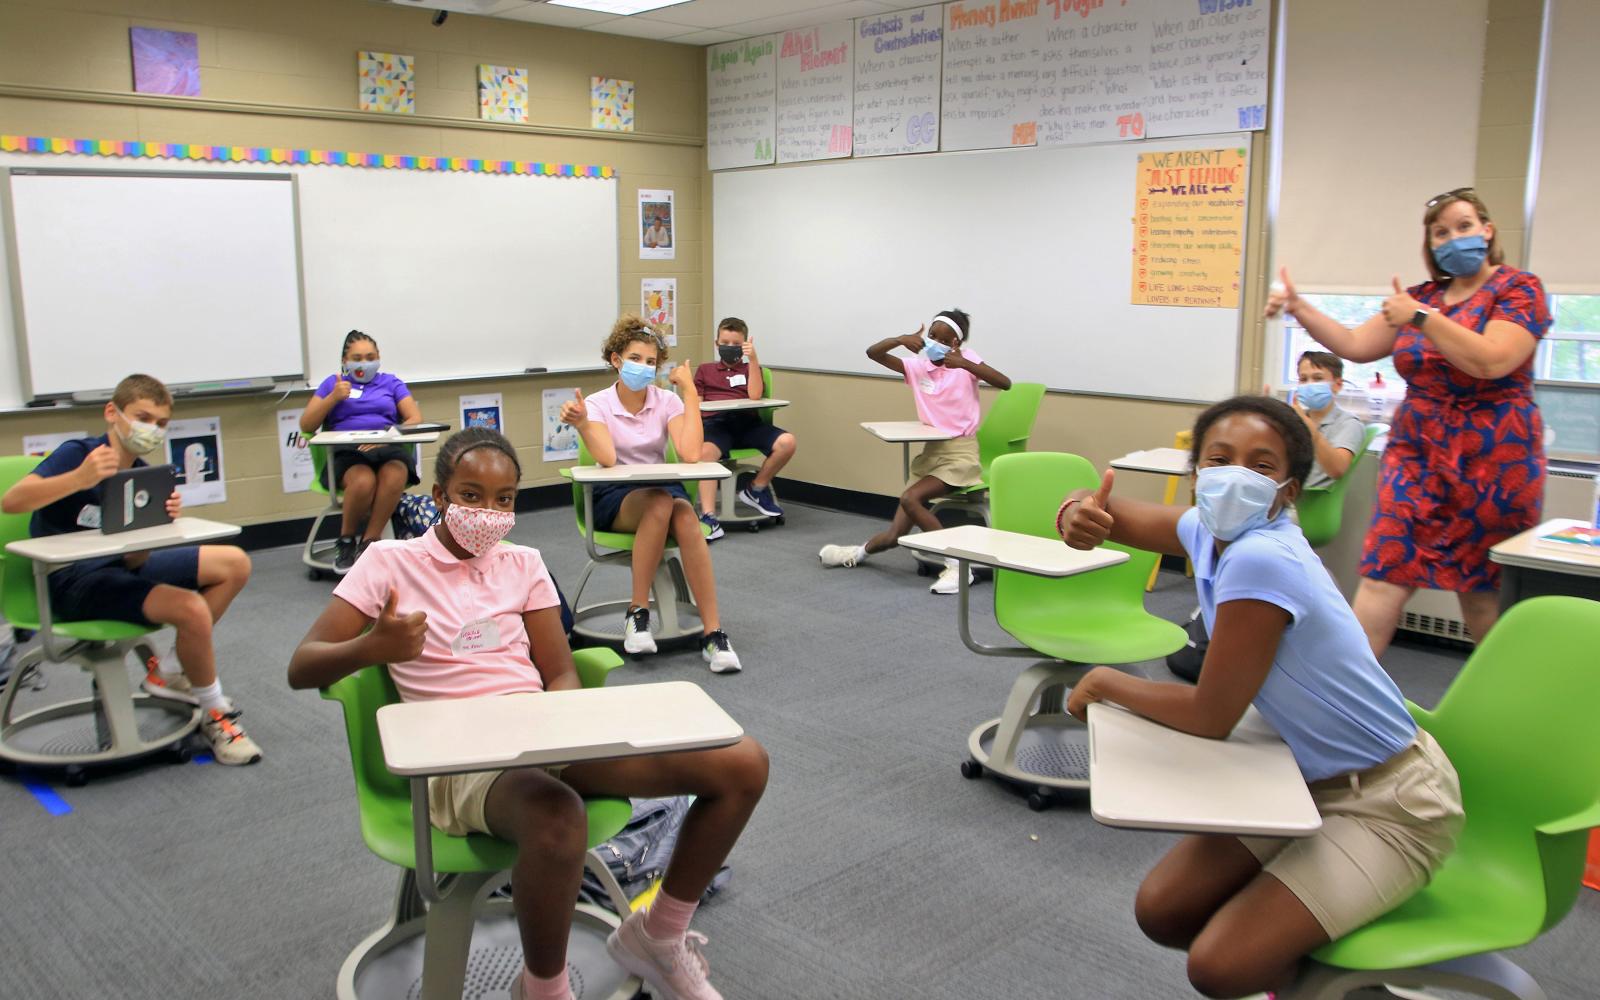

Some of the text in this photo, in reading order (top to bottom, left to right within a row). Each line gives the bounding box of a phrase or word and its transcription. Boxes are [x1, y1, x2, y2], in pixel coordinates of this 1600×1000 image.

[1047, 20, 1137, 42] When a character
[1152, 18, 1183, 38] When
[1188, 17, 1203, 31] an
[1208, 13, 1240, 28] older
[948, 38, 971, 52] When
[974, 34, 987, 48] the
[1178, 33, 1232, 50] character
[1068, 46, 1119, 59] themselves
[857, 53, 938, 75] When a character
[1153, 152, 1175, 168] WE
[1146, 168, 1184, 186] JUST
[1171, 184, 1209, 196] WE ARE
